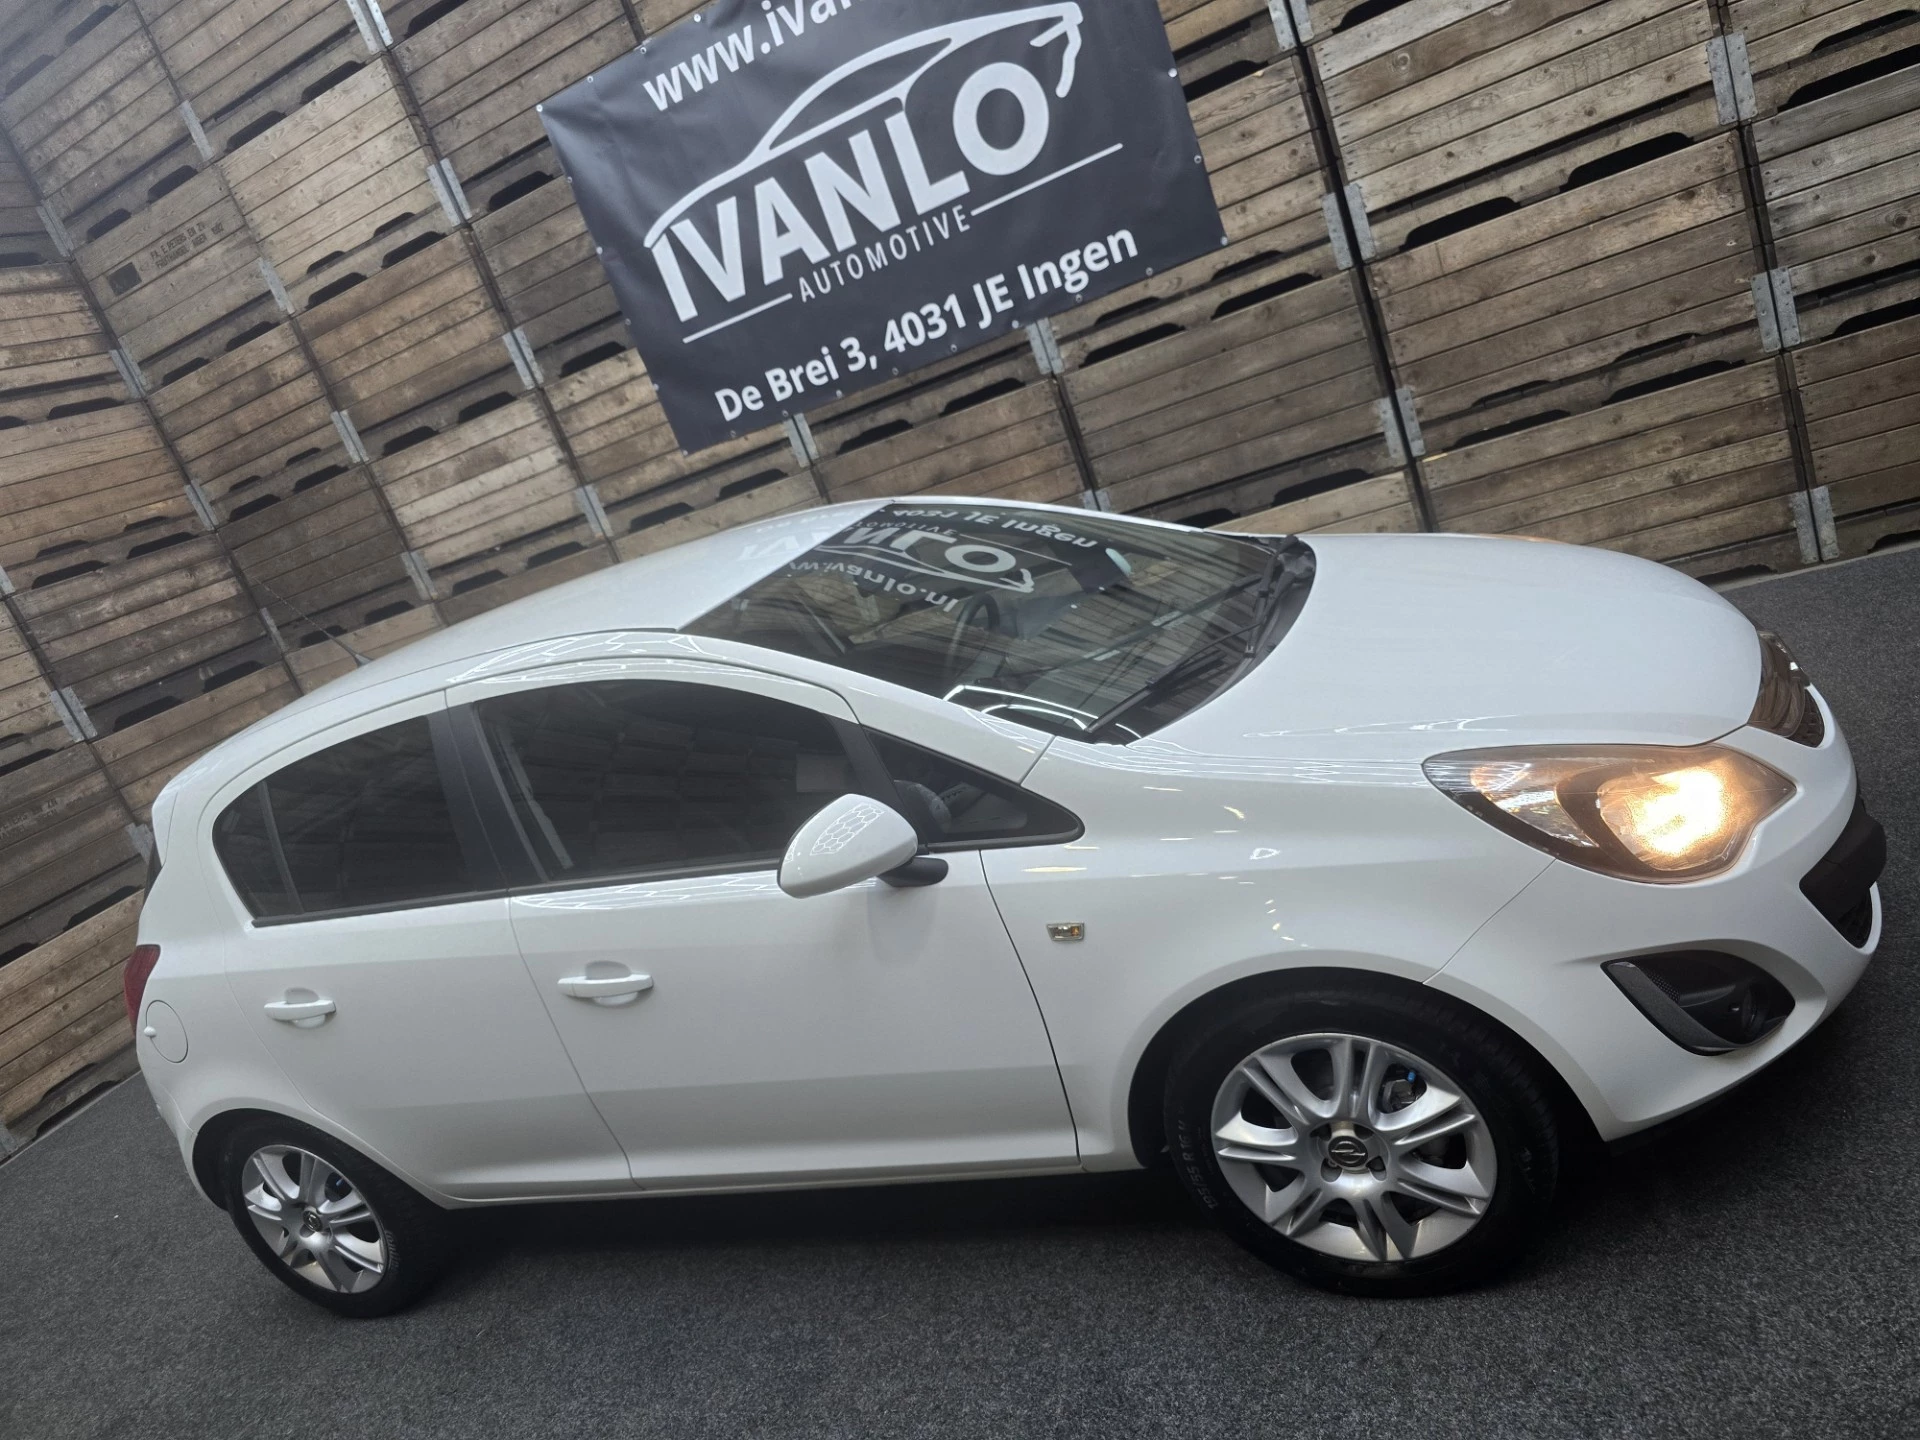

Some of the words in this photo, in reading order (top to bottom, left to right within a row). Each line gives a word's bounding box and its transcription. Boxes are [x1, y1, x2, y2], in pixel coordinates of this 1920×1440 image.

[642, 0, 863, 112] www.iva
[652, 62, 1049, 321] IVANLO
[799, 205, 970, 303] AUTOMOTIVE
[714, 386, 764, 422] De
[764, 345, 840, 402] Brei
[840, 336, 878, 372] 3,
[884, 293, 967, 353] 4031
[973, 273, 1014, 330] JE
[1017, 229, 1138, 300] Ingen
